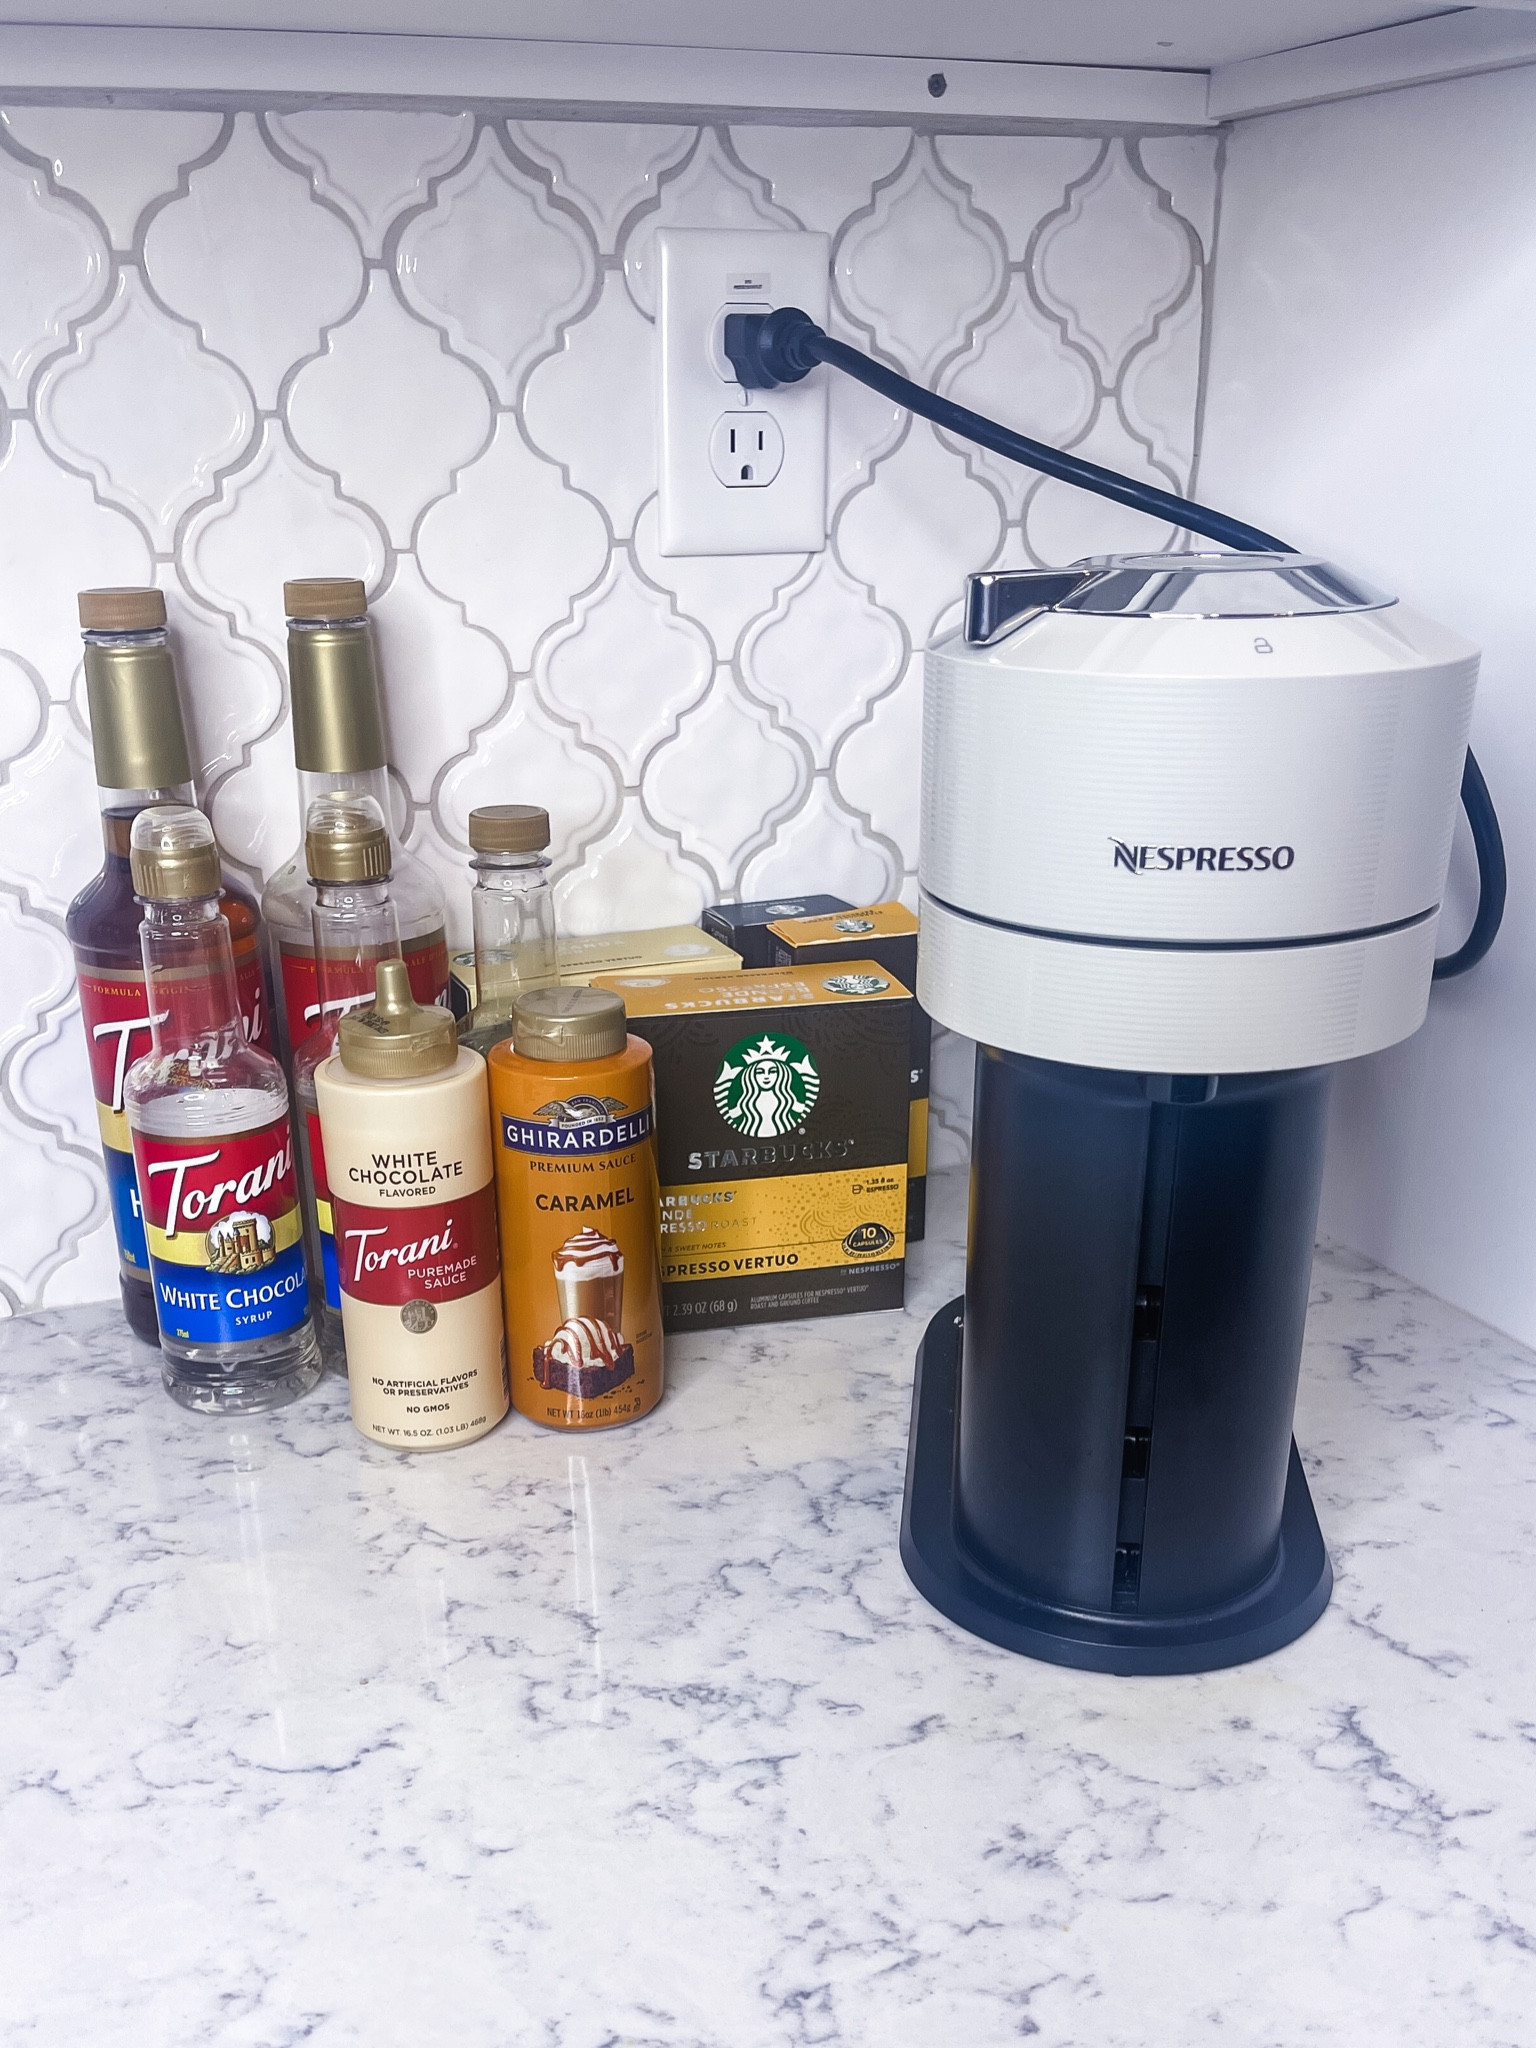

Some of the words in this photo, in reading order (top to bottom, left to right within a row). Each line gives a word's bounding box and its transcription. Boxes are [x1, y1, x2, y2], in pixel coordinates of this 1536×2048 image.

[1107, 836, 1295, 875] NESPRESSO
[310, 965, 364, 975] FRMULA
[93, 984, 142, 997] FORMULA
[506, 1114, 650, 1149] GHIRARDELLI
[371, 1151, 438, 1169] WHITE
[687, 1139, 849, 1170] STARBUCKS
[529, 1160, 595, 1174] PREMIUM
[598, 1153, 637, 1171] SAUCE
[348, 1161, 464, 1185] CHOCOLATE
[147, 1124, 293, 1240] Torani
[866, 1184, 900, 1193] ESPRESSO
[379, 1186, 436, 1198] FLAVORED
[535, 1187, 635, 1212] CARAMEL
[710, 1217, 757, 1230] ROAST
[860, 1227, 877, 1239] 10
[344, 1218, 454, 1282] Torani
[675, 1243, 700, 1252] SWEET
[701, 1241, 727, 1250] NOTES
[852, 1239, 884, 1248] CAPSULES
[407, 1255, 478, 1279] PUREMADE
[733, 1253, 799, 1270] VERTUO
[848, 1264, 896, 1275] NESPRESSO
[424, 1271, 467, 1290] SAUCE
[159, 1283, 221, 1311] WHITE
[673, 1302, 692, 1317] 2.39
[694, 1301, 707, 1314] OZ
[709, 1300, 725, 1314] (68
[727, 1299, 738, 1313] g)
[235, 1311, 273, 1326] SYRUP
[372, 1377, 384, 1386] NO
[387, 1379, 438, 1388] ARTIFICIAL
[440, 1369, 478, 1385] FLAVORS
[383, 1387, 396, 1396] OR
[398, 1381, 469, 1397] PRESERVATIVES
[406, 1406, 421, 1414] NO
[423, 1403, 450, 1413] GMOS
[547, 1407, 561, 1418] NET
[562, 1408, 575, 1419] WT
[613, 1403, 631, 1415] 454g
[372, 1424, 386, 1433] NET
[455, 1422, 469, 1432] LB)
